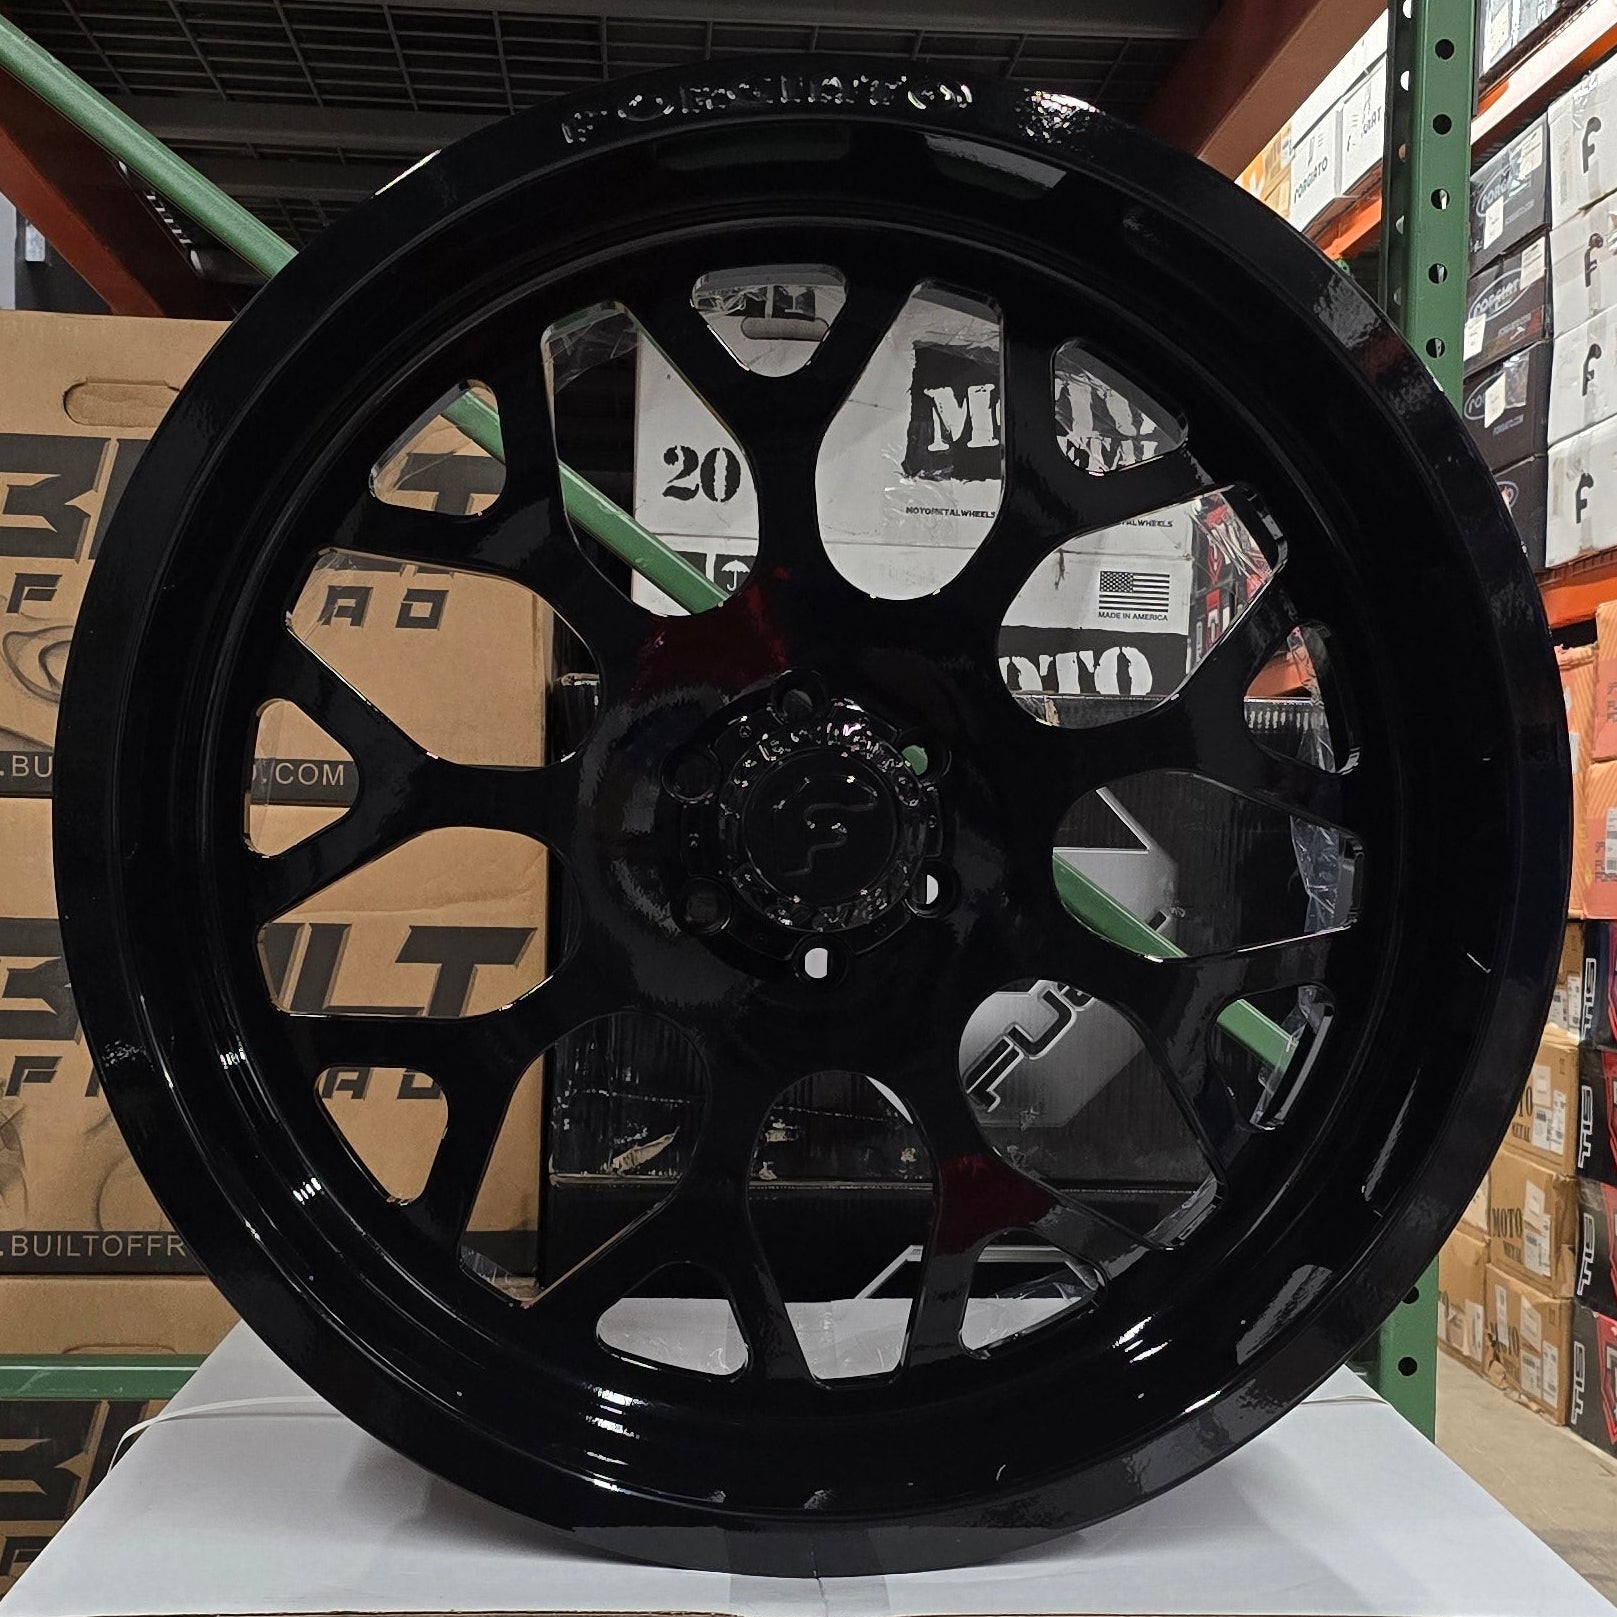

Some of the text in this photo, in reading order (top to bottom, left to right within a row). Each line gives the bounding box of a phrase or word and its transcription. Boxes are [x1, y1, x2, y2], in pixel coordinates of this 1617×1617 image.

[662, 445, 741, 502] 20
[1132, 613, 1168, 621] AMERICA
[1492, 1208, 1522, 1238] MOTO
